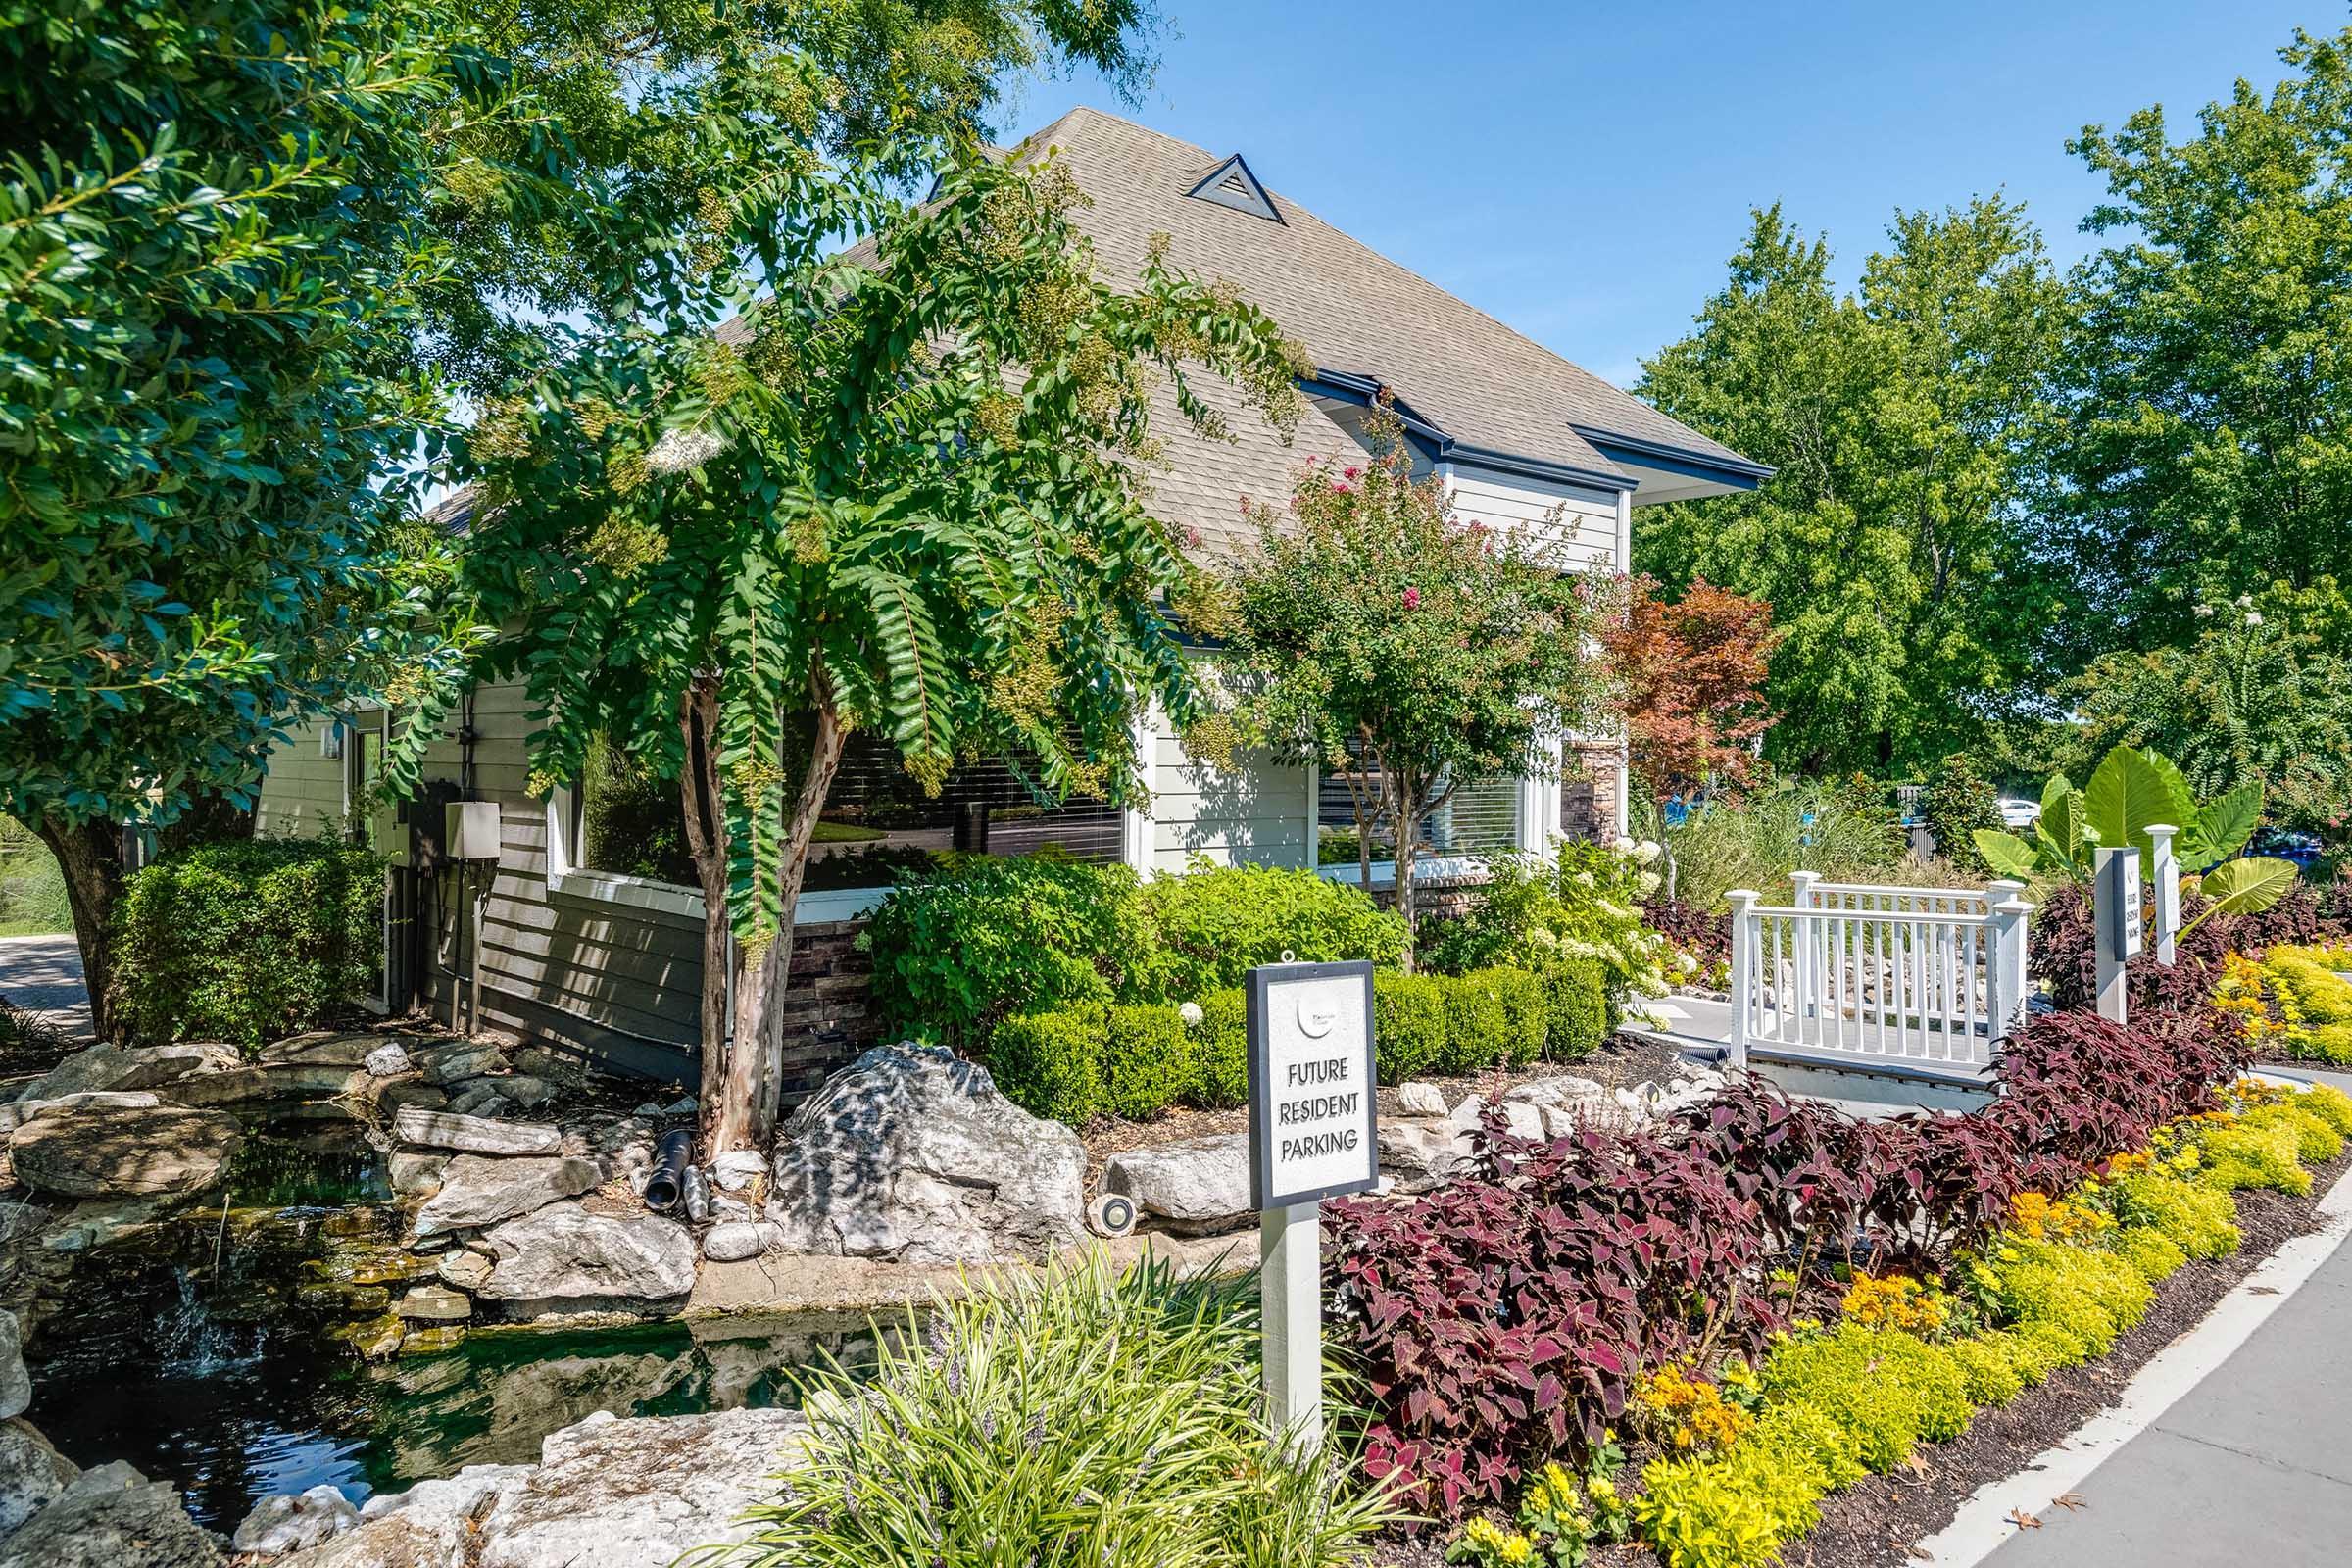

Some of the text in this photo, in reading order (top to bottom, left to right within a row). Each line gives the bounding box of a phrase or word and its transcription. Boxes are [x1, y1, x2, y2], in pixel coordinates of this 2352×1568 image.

[1288, 1057, 1348, 1085] FUTURE
[1279, 1092, 1359, 1125] RESIDENT
[1281, 1129, 1358, 1161] PARKING
